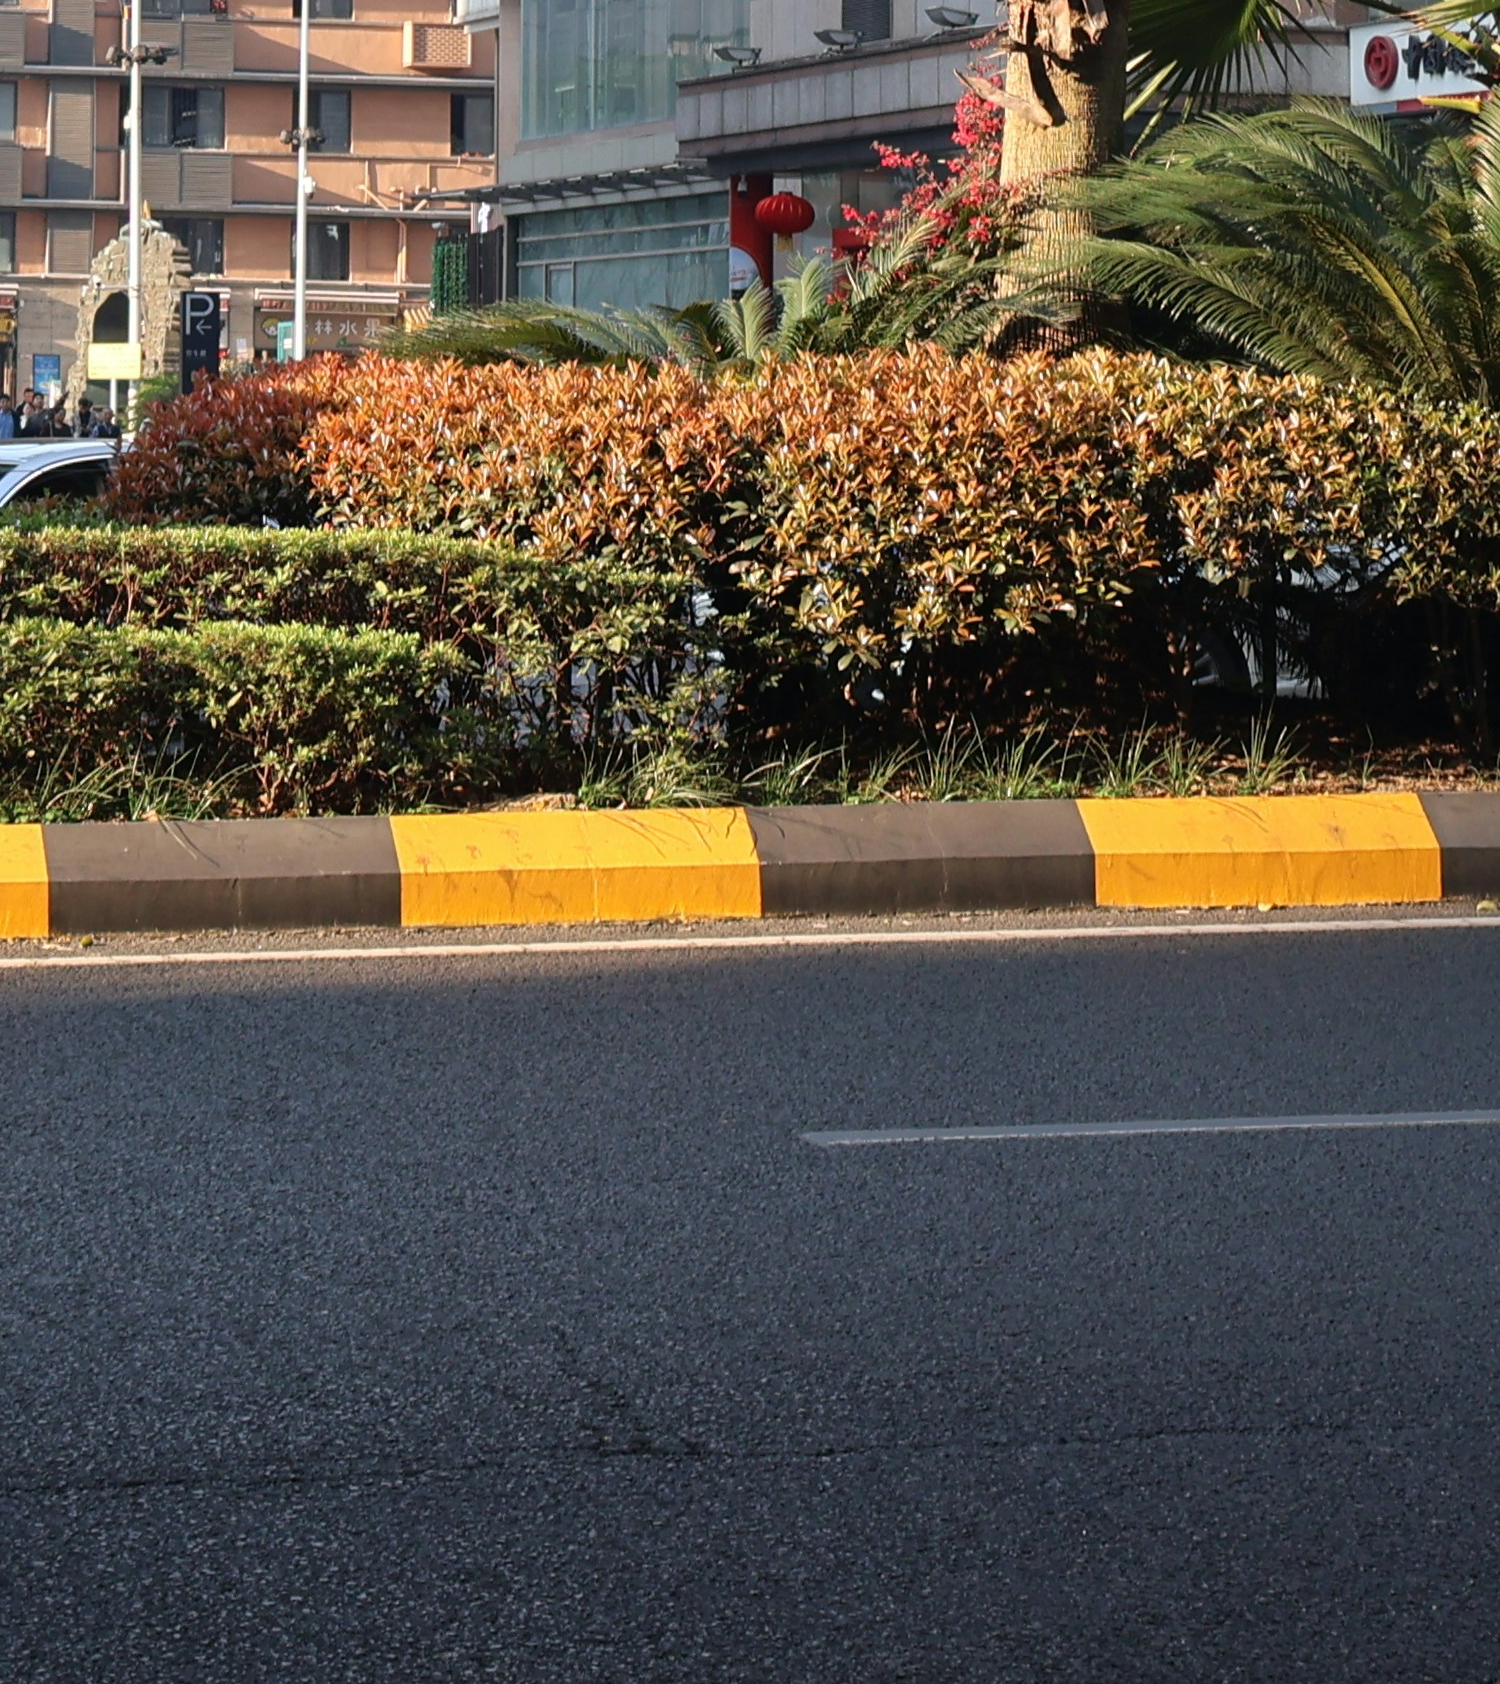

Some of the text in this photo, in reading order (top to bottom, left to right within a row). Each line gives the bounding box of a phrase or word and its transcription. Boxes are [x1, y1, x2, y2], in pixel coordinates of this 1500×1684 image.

[185, 292, 214, 335] P
[304, 317, 381, 336] 林水果
